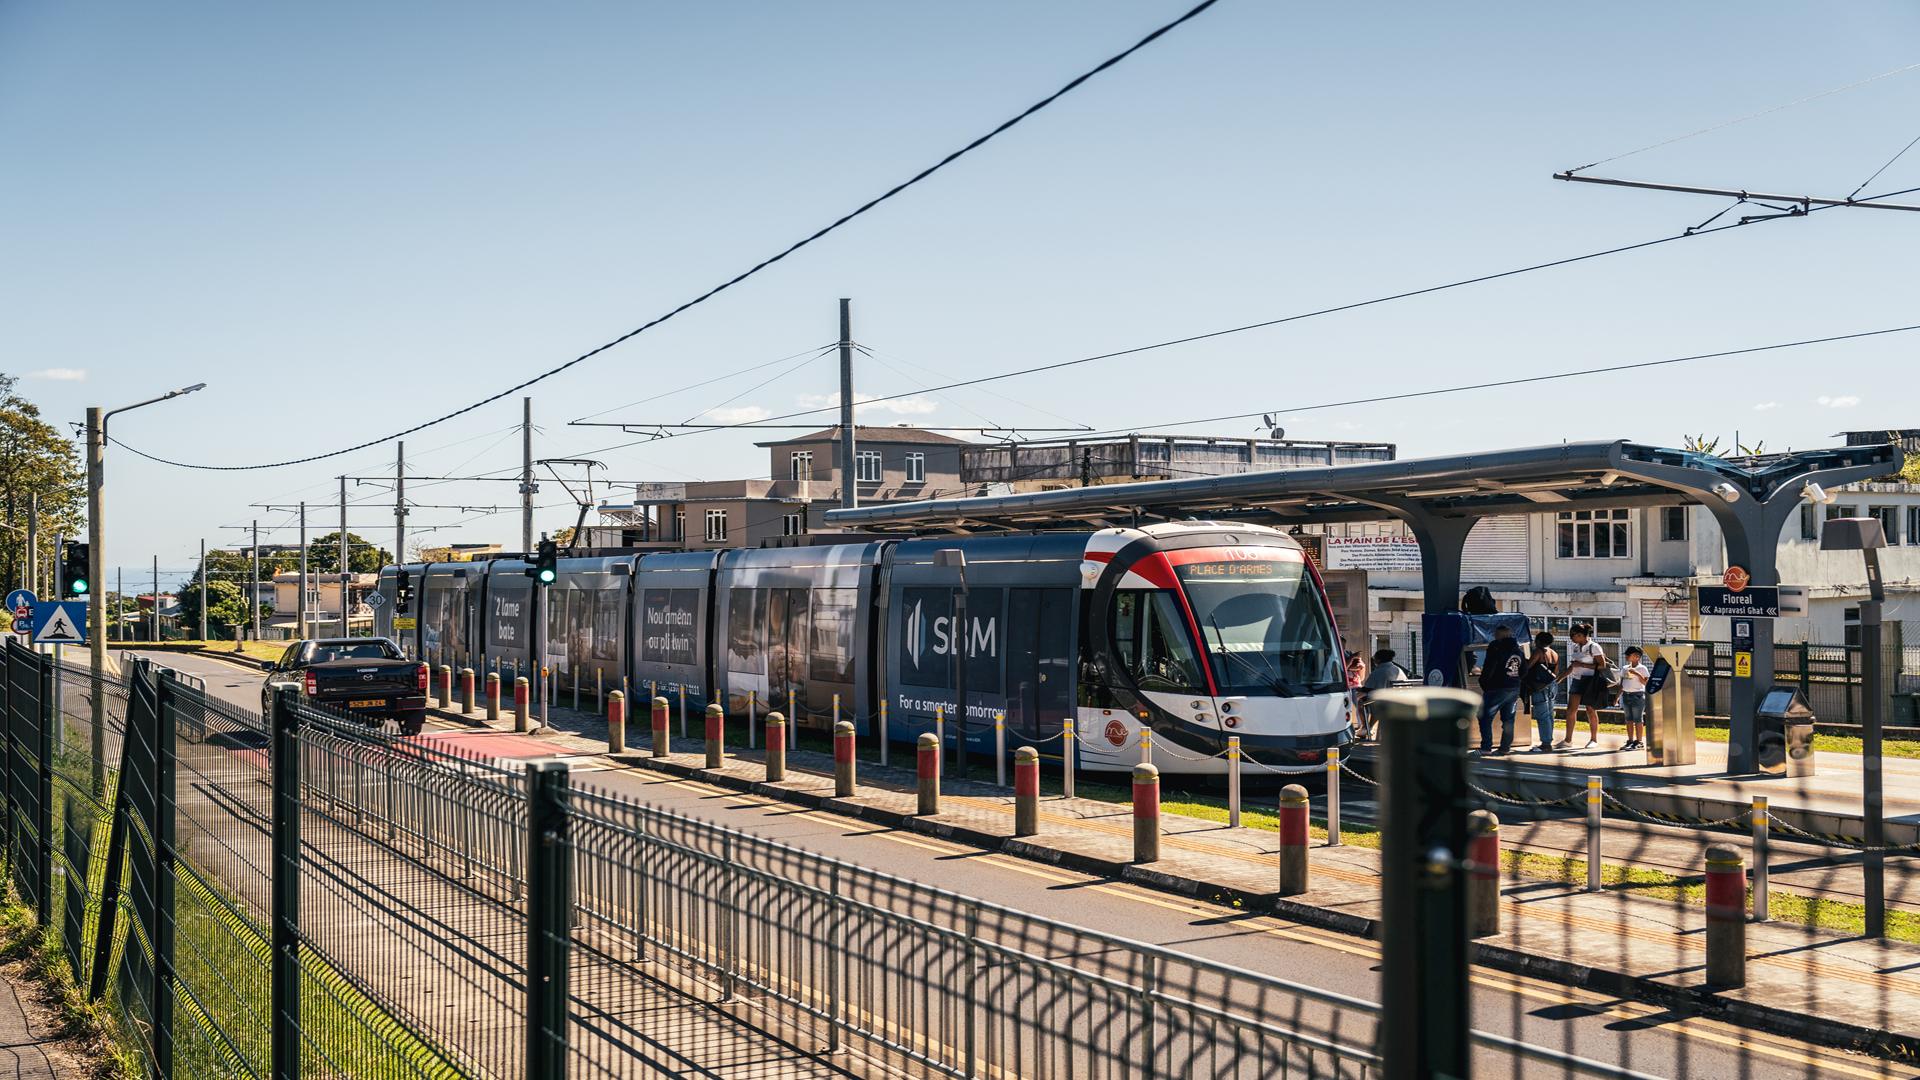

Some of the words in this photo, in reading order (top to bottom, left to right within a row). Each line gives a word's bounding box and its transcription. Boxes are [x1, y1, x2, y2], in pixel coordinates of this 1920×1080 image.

[1190, 564, 1225, 575] PLACE
[1229, 564, 1273, 575] D'ARMES
[369, 595, 383, 605] 30
[501, 597, 520, 617] lame
[1722, 594, 1753, 605] Floreal
[647, 607, 664, 625] Nou
[1713, 606, 1746, 615] Aapravasi
[1747, 606, 1764, 615] Ghat
[498, 620, 515, 640] bate
[648, 636, 659, 648] ou
[672, 632, 689, 651] twin
[899, 694, 914, 709] For
[915, 700, 921, 710] a
[922, 700, 958, 715] smater
[965, 704, 1007, 720] omorrow
